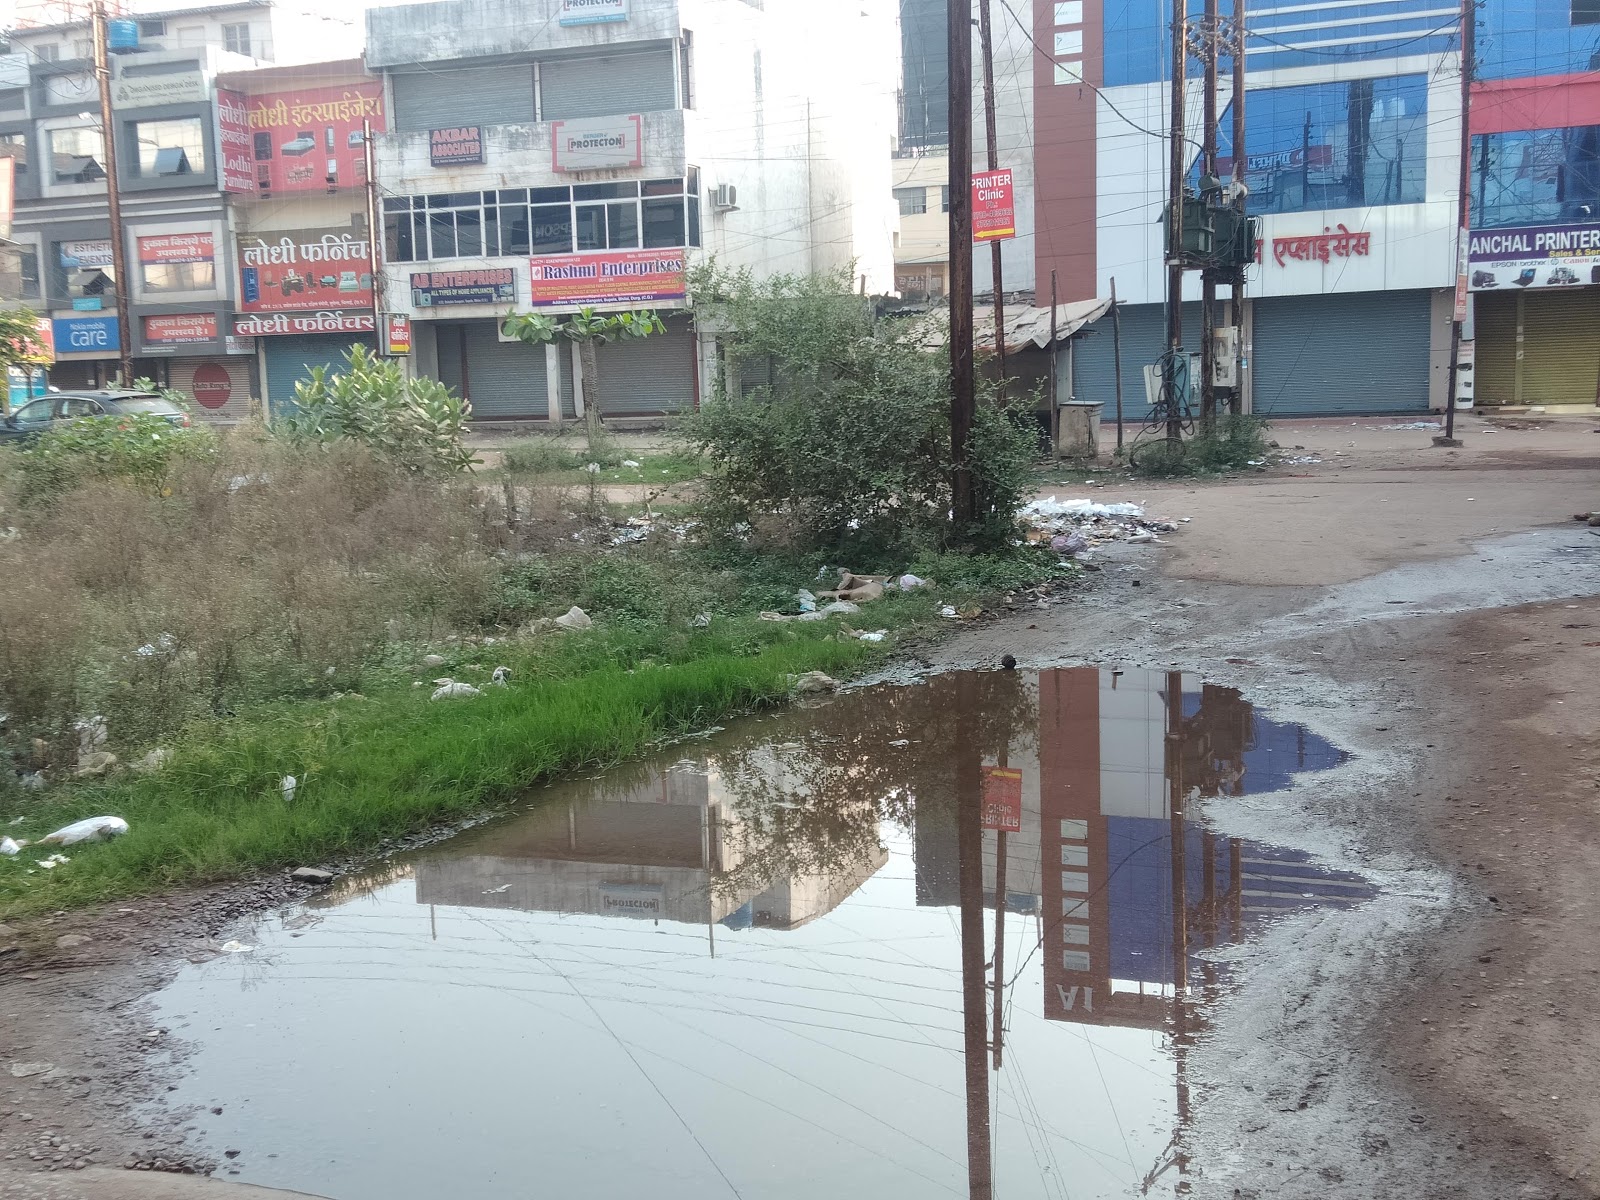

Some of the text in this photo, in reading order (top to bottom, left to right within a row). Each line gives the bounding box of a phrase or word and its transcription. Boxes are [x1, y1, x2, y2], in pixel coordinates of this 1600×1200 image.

[220, 99, 249, 126] लोधी
[249, 100, 289, 128] लोधी
[431, 127, 480, 143] AKBAR
[570, 138, 621, 149] PROTECTON
[431, 141, 480, 157] ASSOCIATES
[222, 152, 252, 172] Lodhi
[223, 172, 253, 190] Furniture
[971, 174, 1011, 189] PRINTER
[978, 189, 1004, 201] Clinic
[74, 242, 112, 253] ESTHETI
[242, 237, 297, 266] लोधी
[1470, 234, 1532, 255] ANCHAL
[1549, 249, 1573, 258] Sales
[1576, 249, 1582, 257] &
[542, 262, 597, 281] Rashmi
[600, 257, 683, 277] Enterprises
[412, 274, 429, 289] AB
[431, 268, 512, 288] ENTERPRISES
[234, 310, 375, 335] लोधी फर्निचर
[71, 331, 107, 346] care
